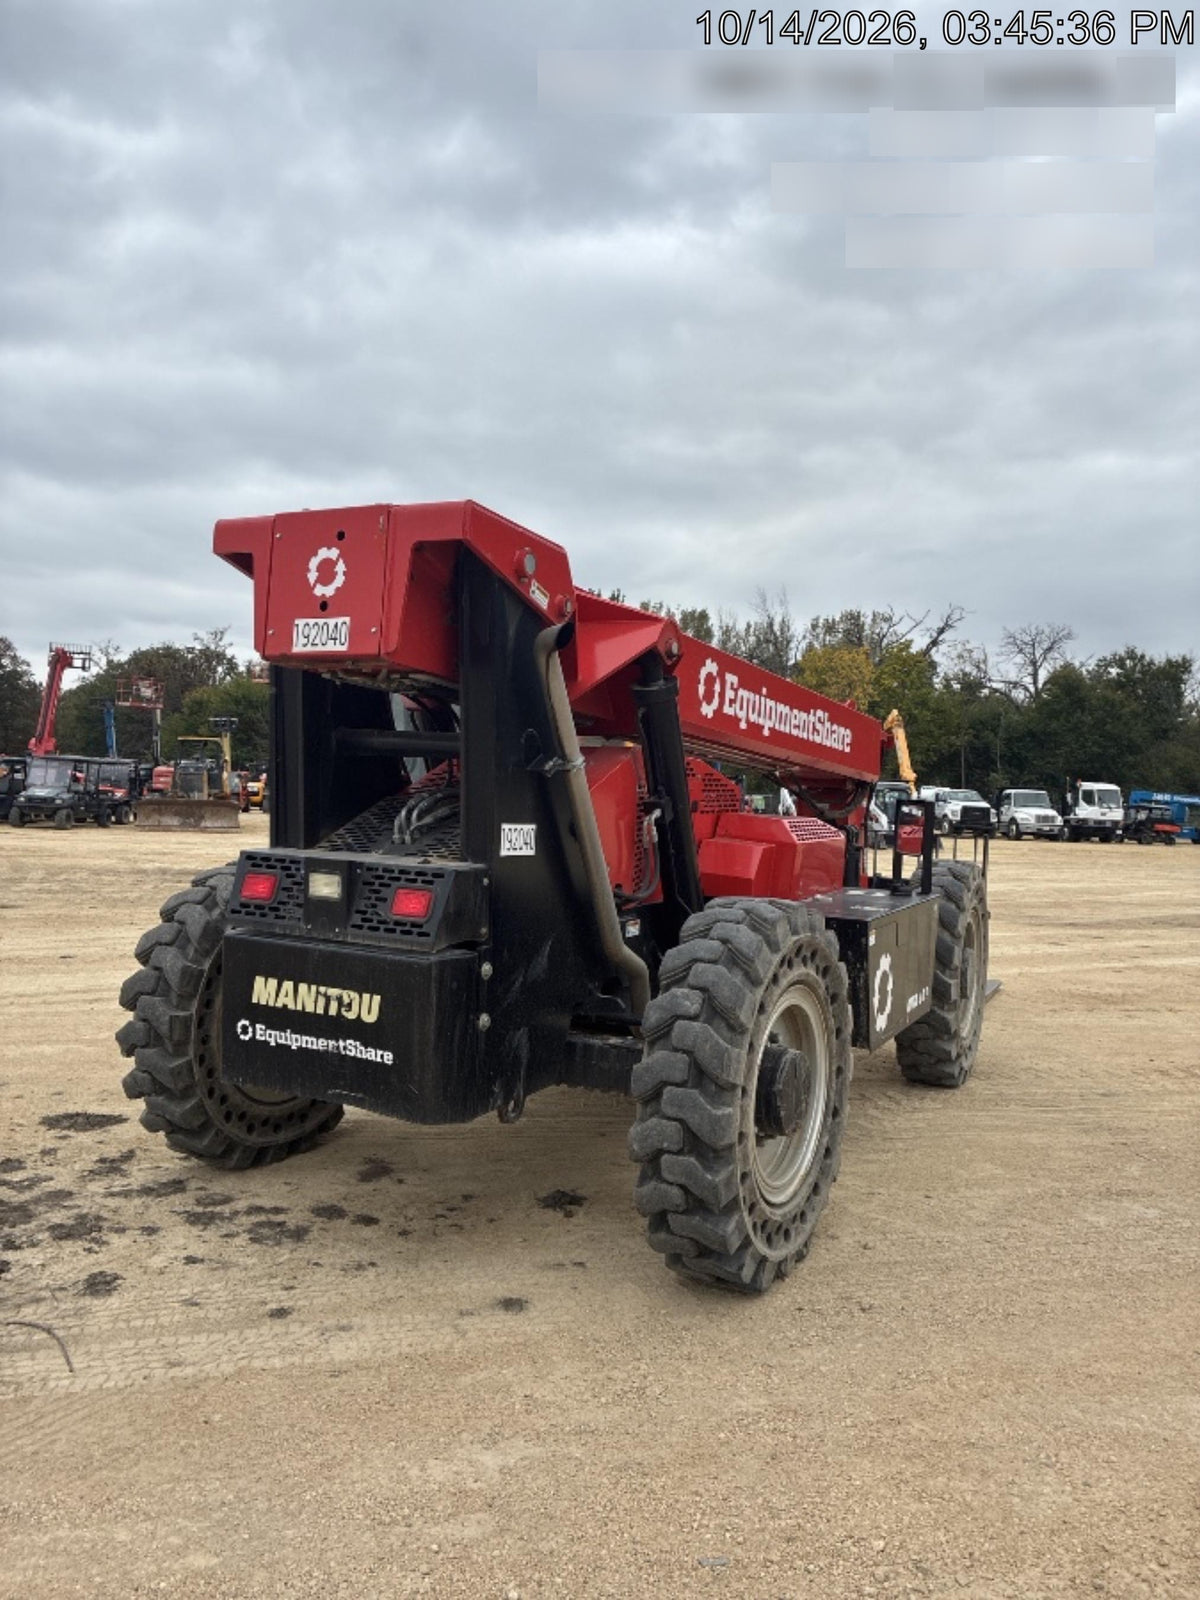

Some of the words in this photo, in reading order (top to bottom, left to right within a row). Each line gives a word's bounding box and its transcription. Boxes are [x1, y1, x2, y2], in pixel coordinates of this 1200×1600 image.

[294, 621, 348, 648] 192040
[723, 672, 852, 752] EquipmentShare
[502, 827, 535, 851] 192040
